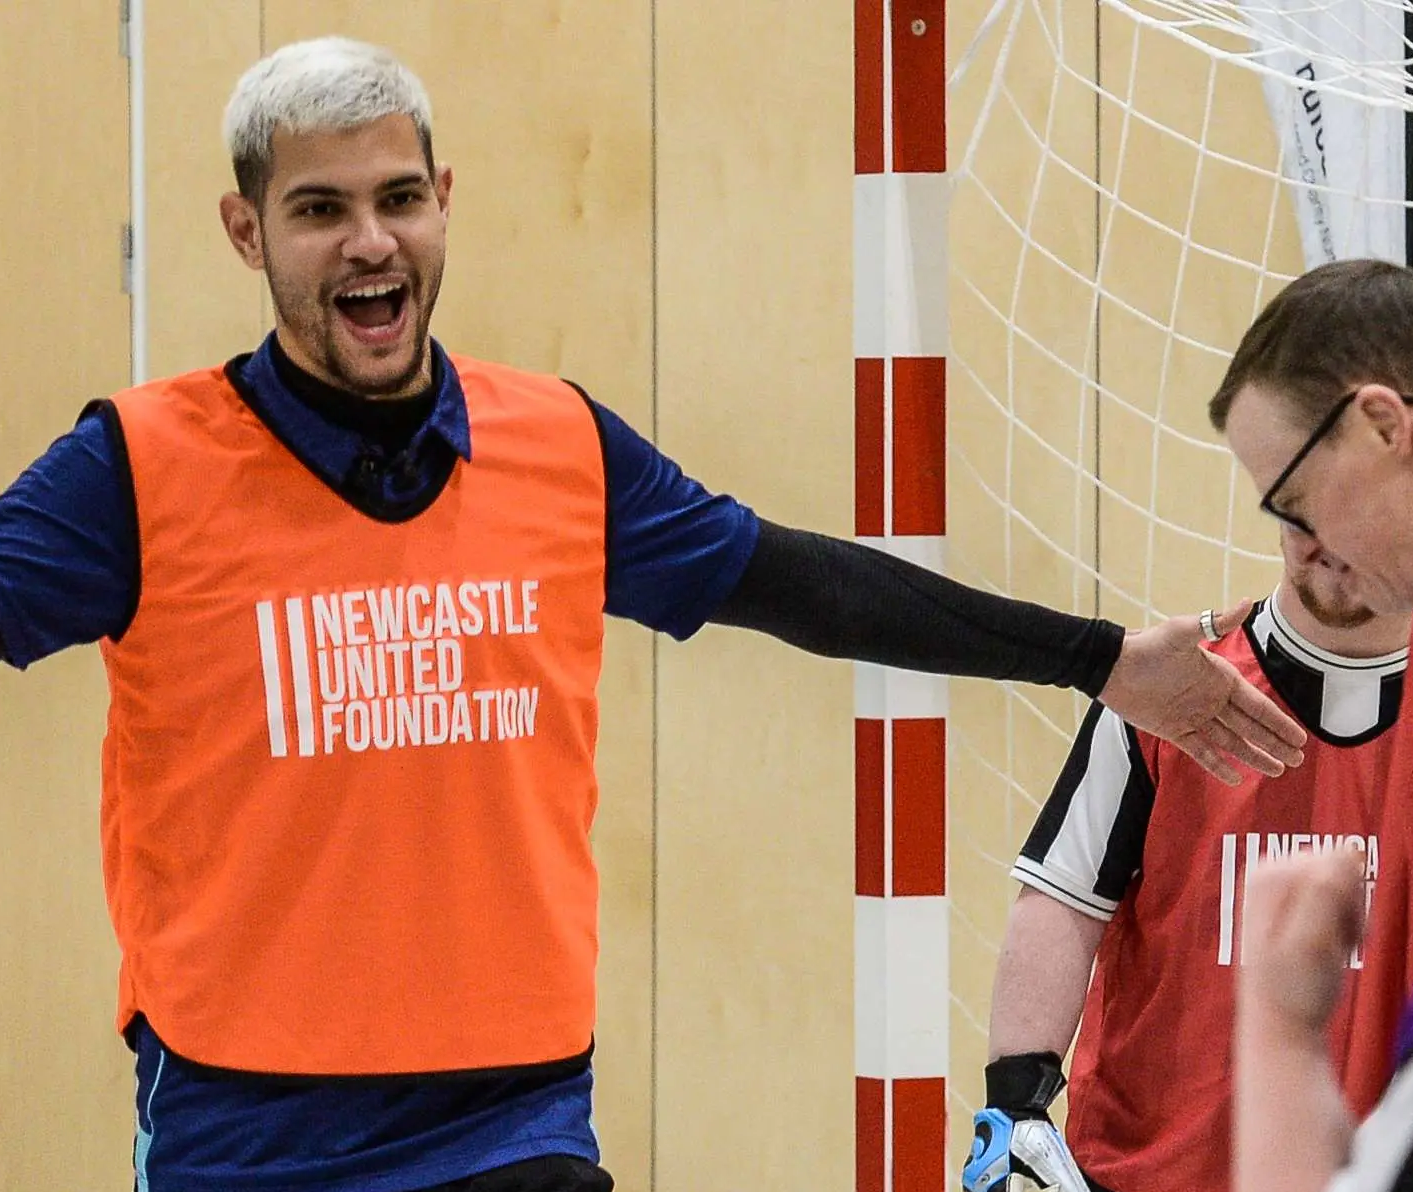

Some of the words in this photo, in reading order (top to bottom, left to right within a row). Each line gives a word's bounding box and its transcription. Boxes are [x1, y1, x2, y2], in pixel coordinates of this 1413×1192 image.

[311, 580, 539, 649] NEWCASTLE
[317, 638, 463, 704] UNITED
[323, 687, 539, 754] FOUNDATION
